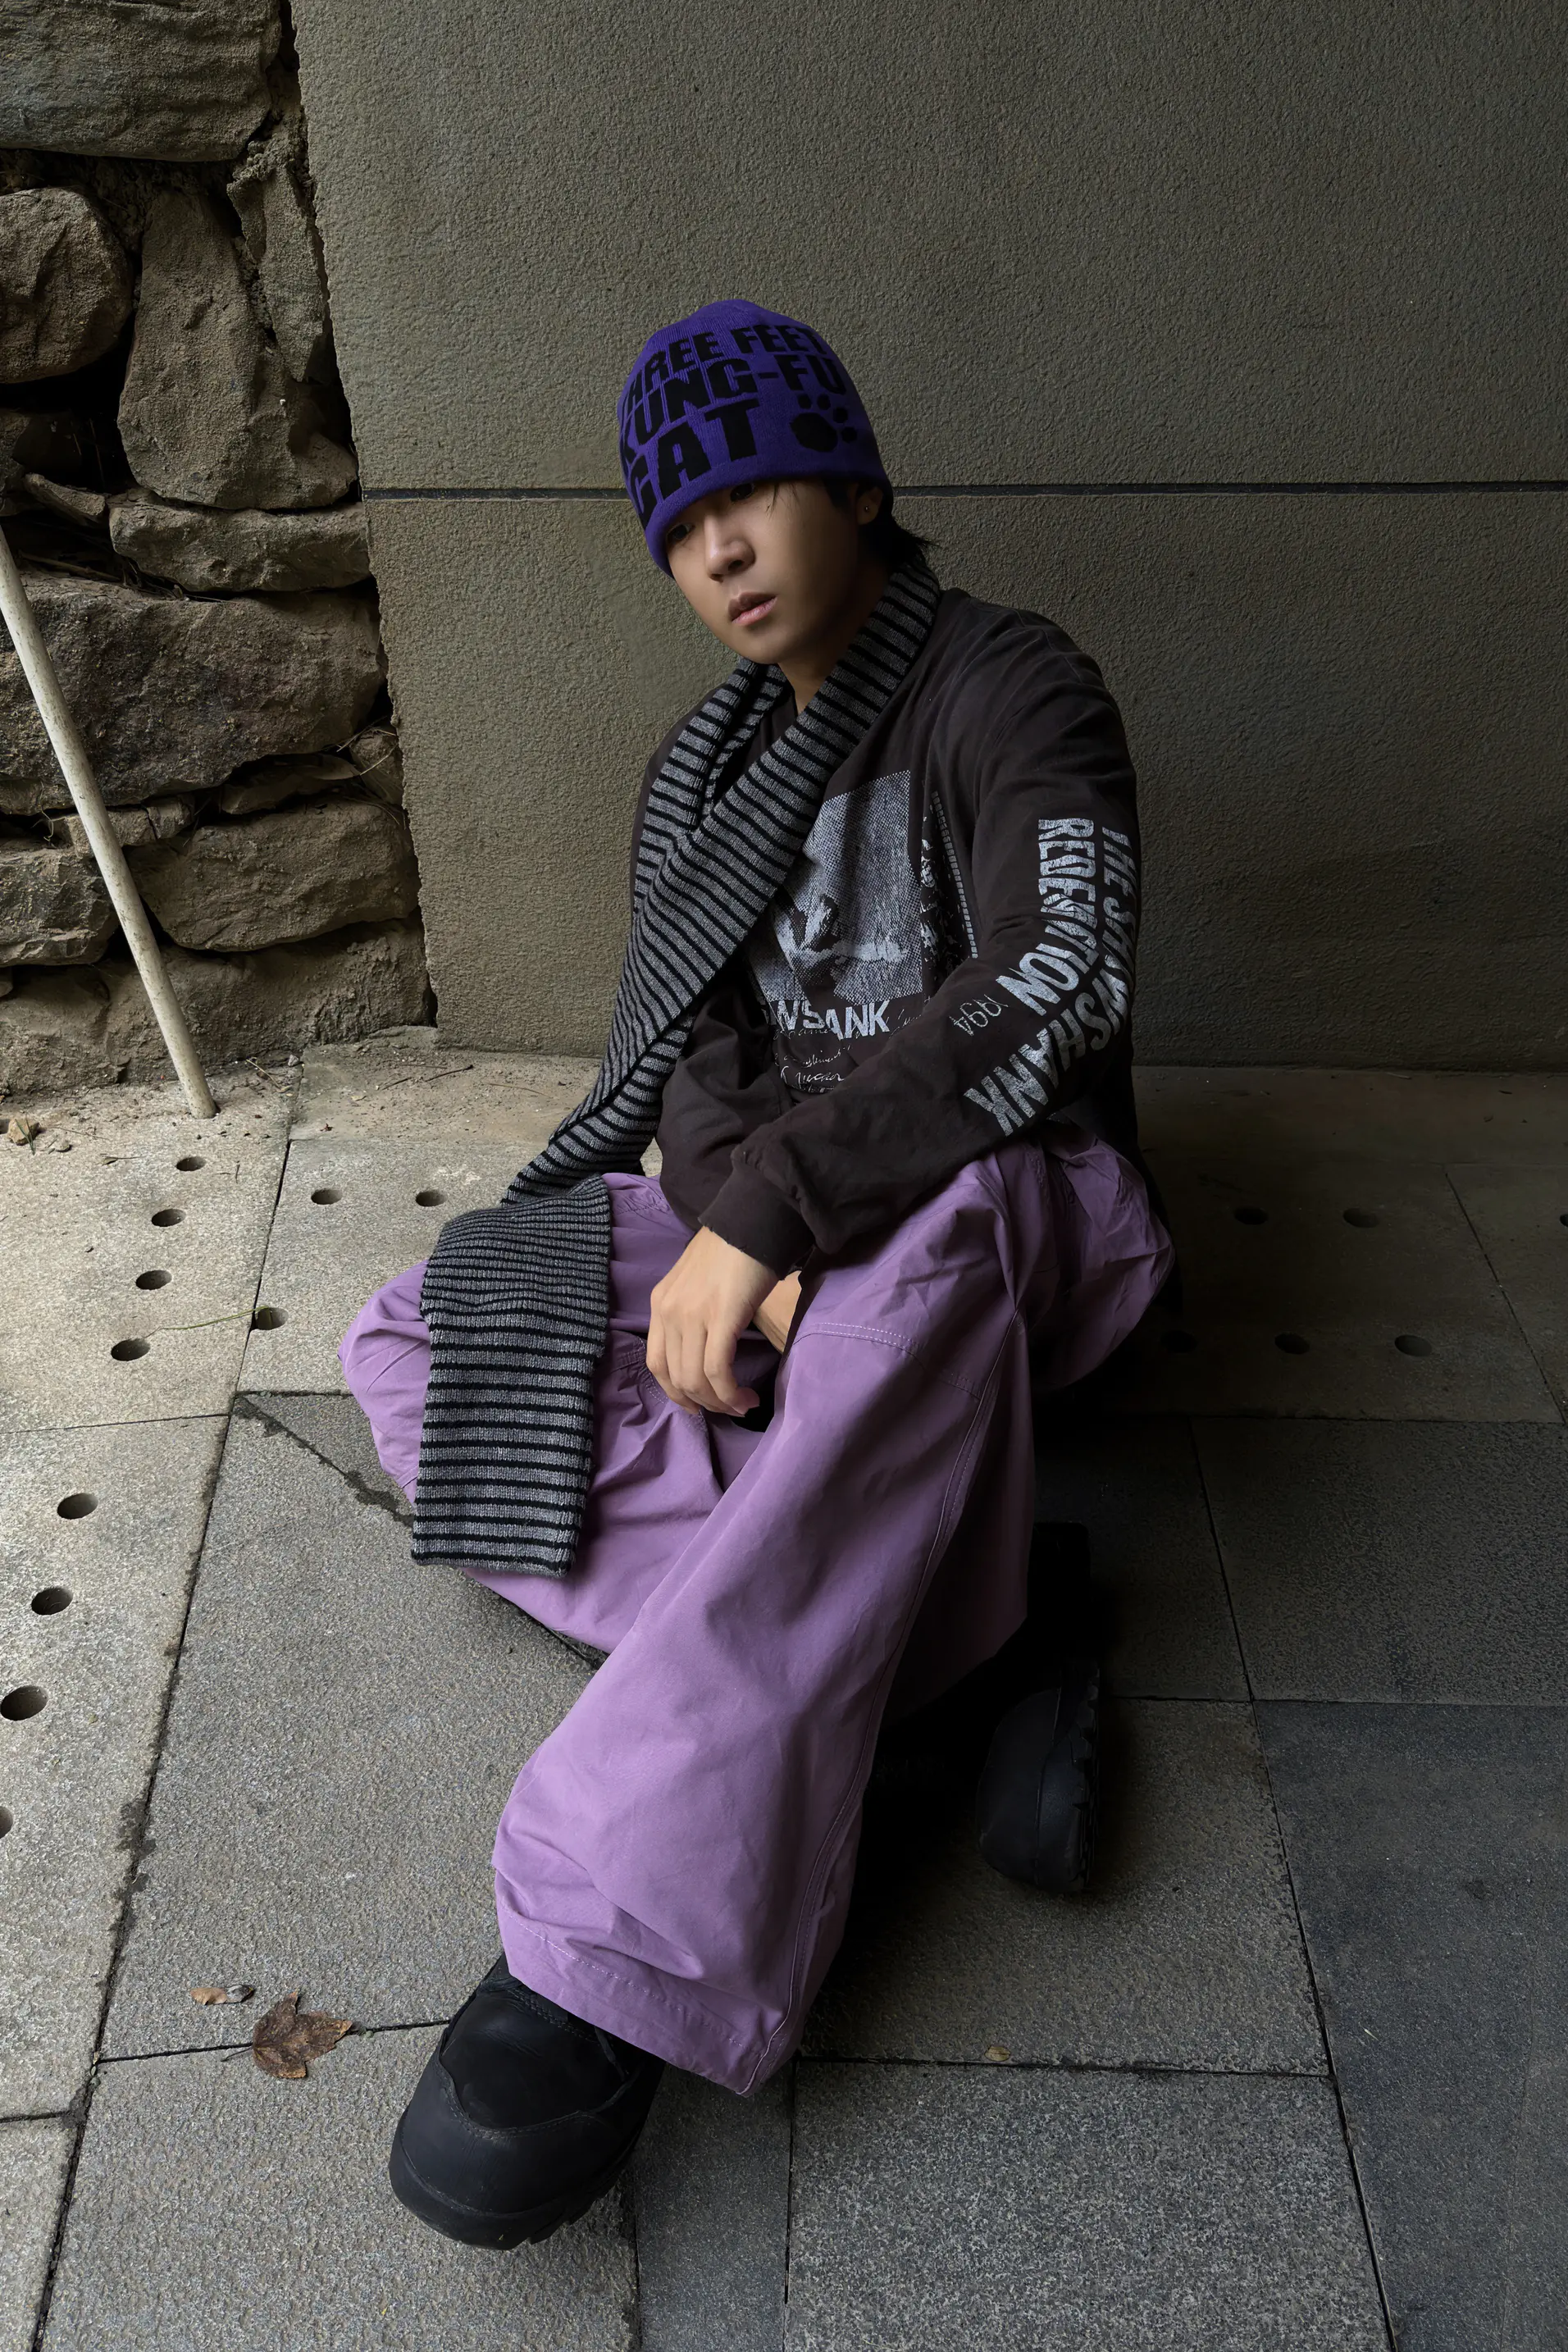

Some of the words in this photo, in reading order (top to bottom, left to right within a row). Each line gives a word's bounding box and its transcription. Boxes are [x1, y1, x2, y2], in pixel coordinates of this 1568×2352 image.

[731, 324, 827, 354] FEET
[631, 399, 760, 531] CAT
[1101, 826, 1138, 899] THE
